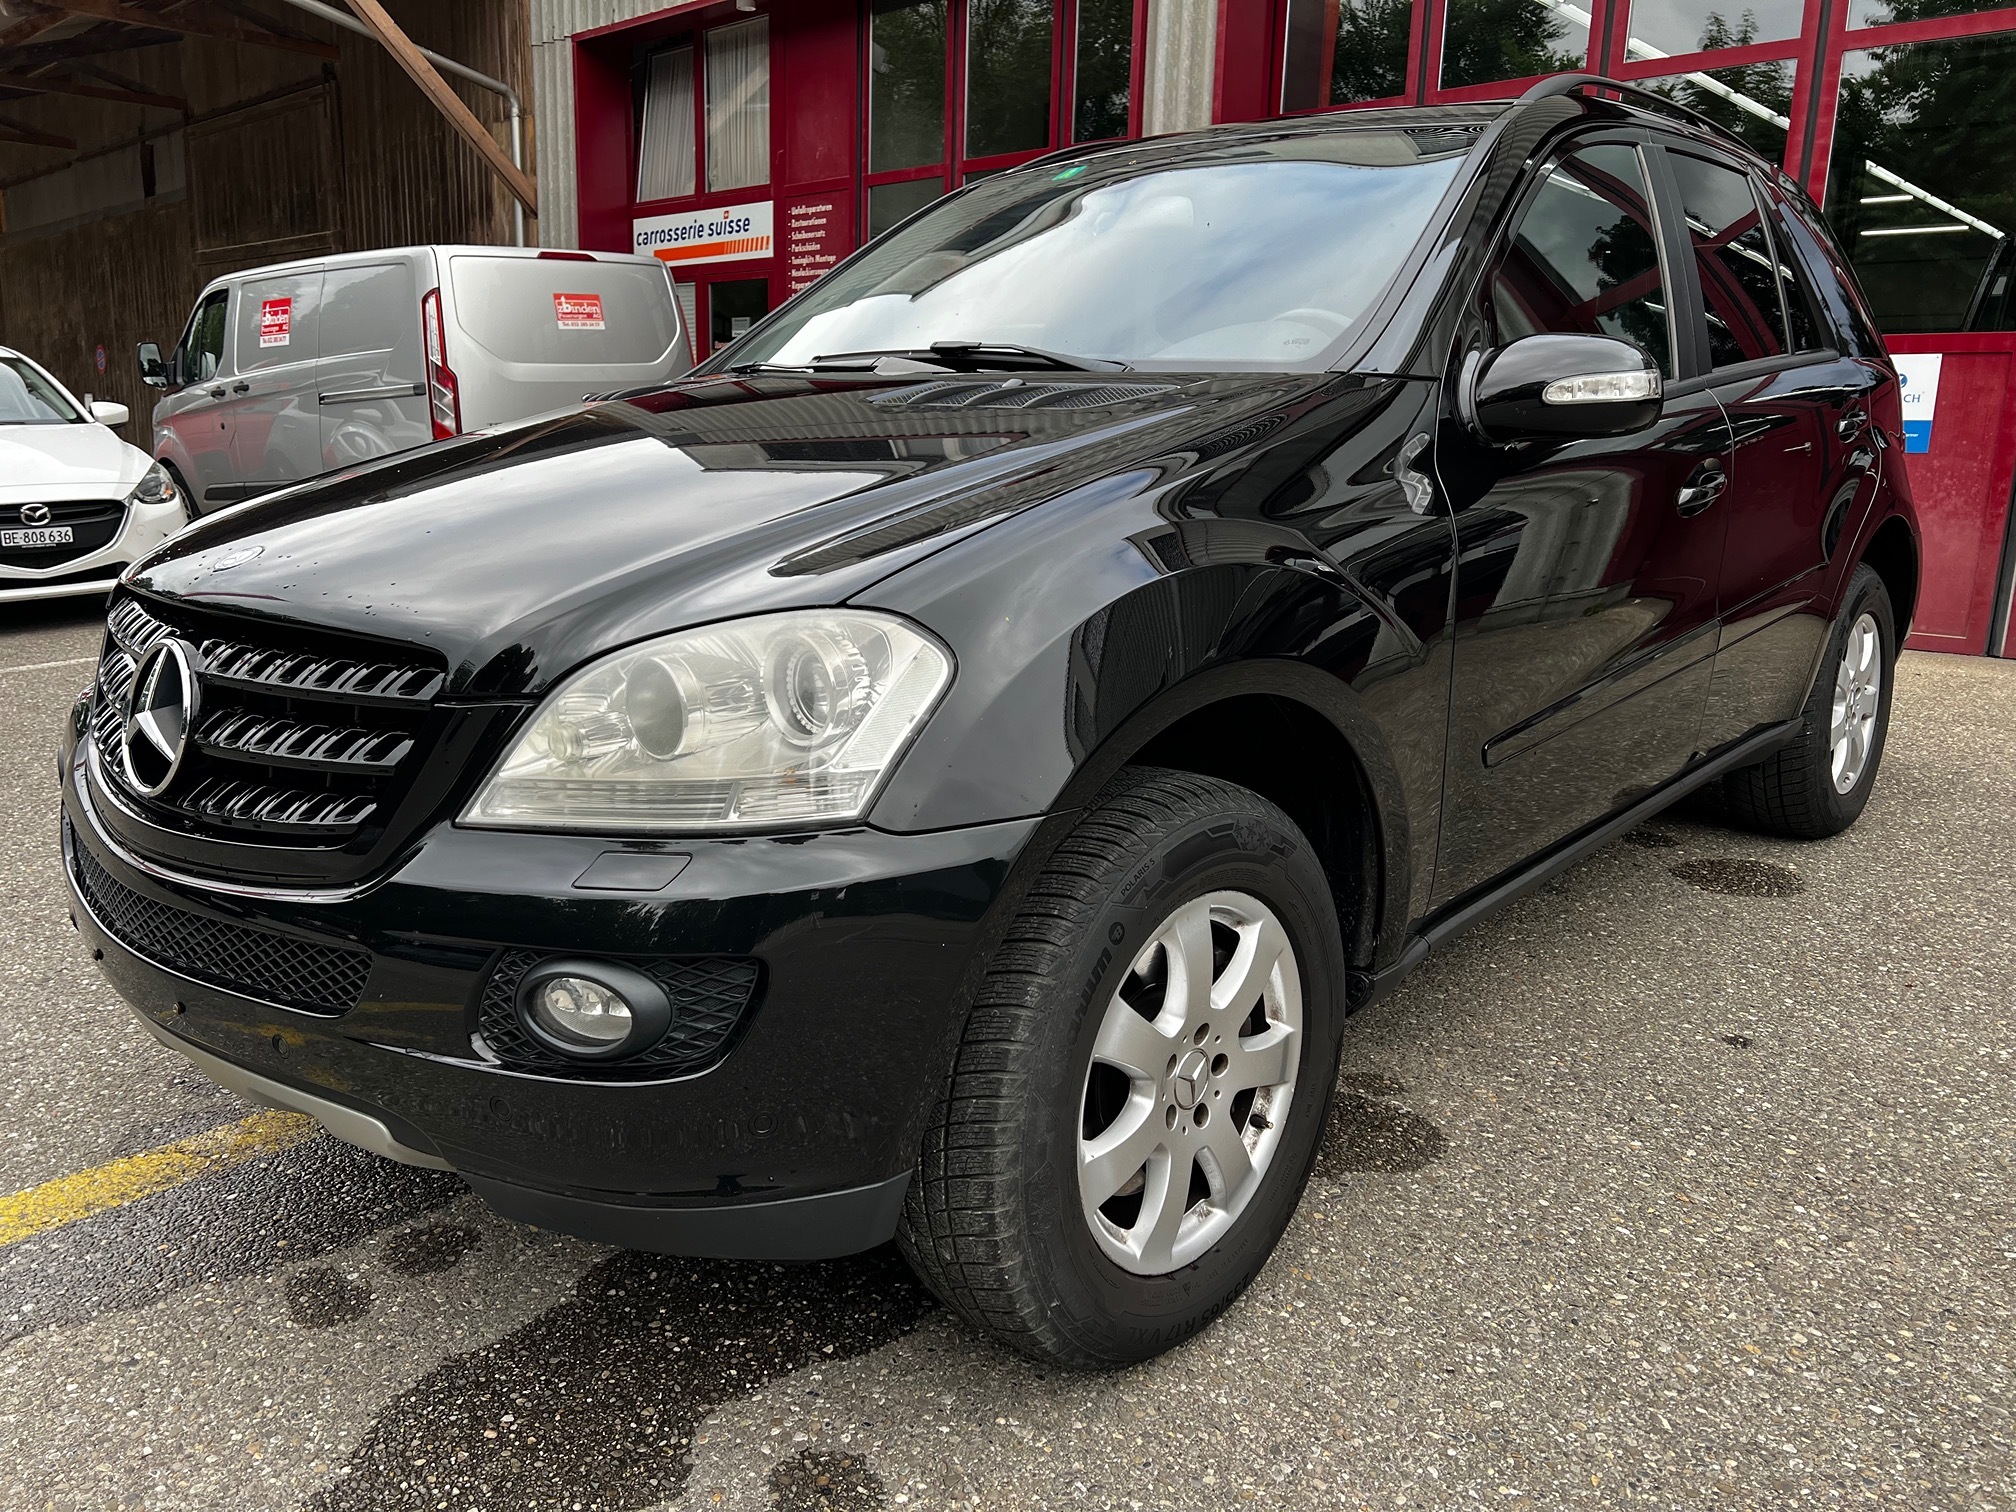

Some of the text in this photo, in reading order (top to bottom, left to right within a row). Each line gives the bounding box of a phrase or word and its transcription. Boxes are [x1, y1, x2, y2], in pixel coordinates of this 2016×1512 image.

[791, 217, 827, 228] Restaurationen
[636, 213, 751, 246] carrosserie suisse
[791, 230, 826, 240] Scheibenersatz
[791, 242, 821, 252] Parkschäden
[815, 254, 837, 264] Montage
[48, 529, 71, 542] 636
[1120, 862, 1150, 897] POLARIS
[1164, 1316, 1197, 1343] R17
